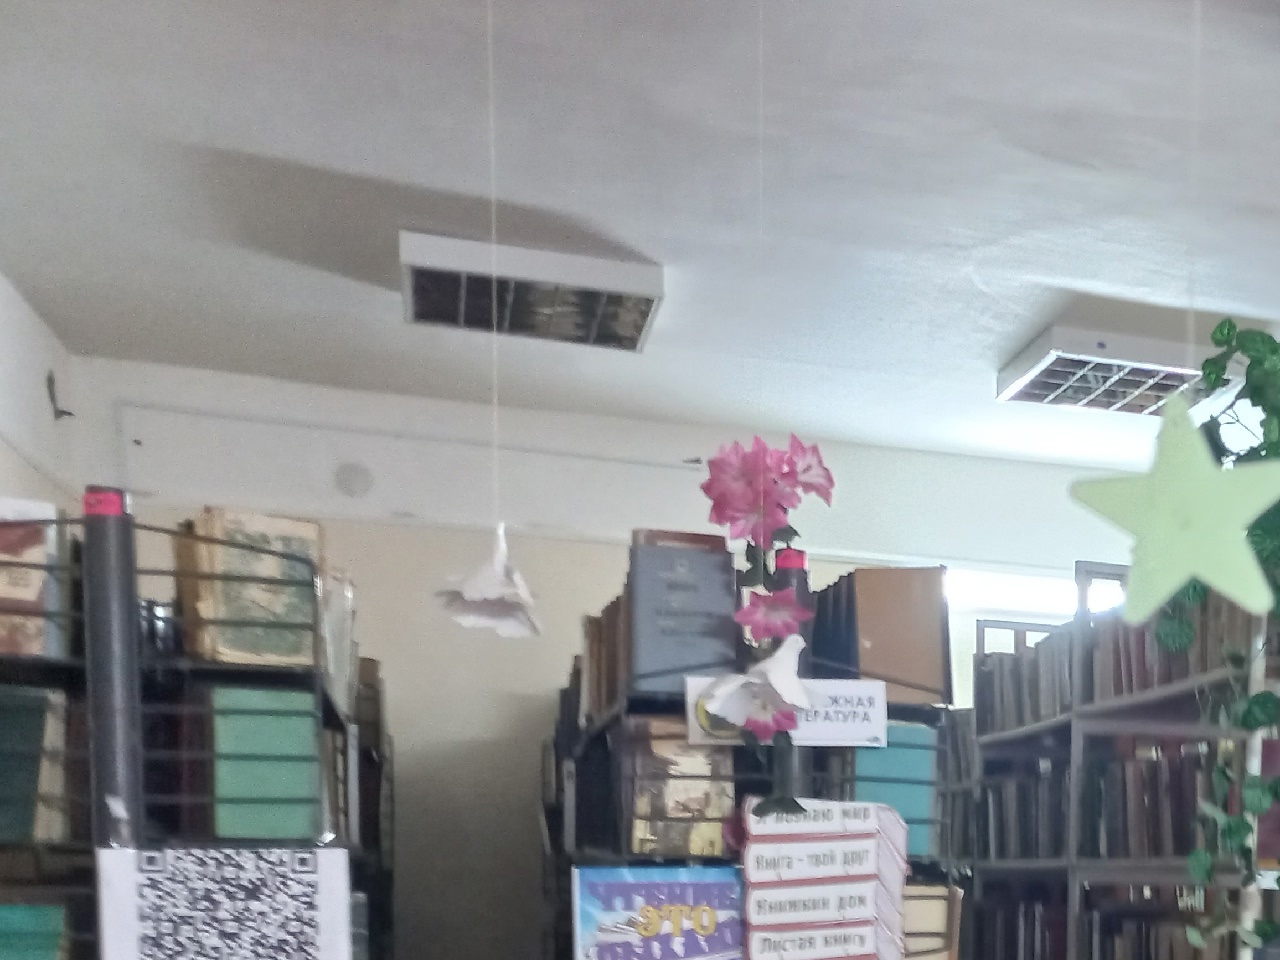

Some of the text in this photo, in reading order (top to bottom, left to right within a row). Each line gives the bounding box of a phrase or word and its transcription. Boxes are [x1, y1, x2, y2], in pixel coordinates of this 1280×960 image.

[820, 694, 877, 710] ЖНАЯ
[798, 708, 873, 724] ТЕРАТУРА
[756, 854, 794, 872] Книга
[842, 849, 870, 867] друг
[636, 904, 718, 938] ЭТО
[760, 936, 816, 955] Листая
